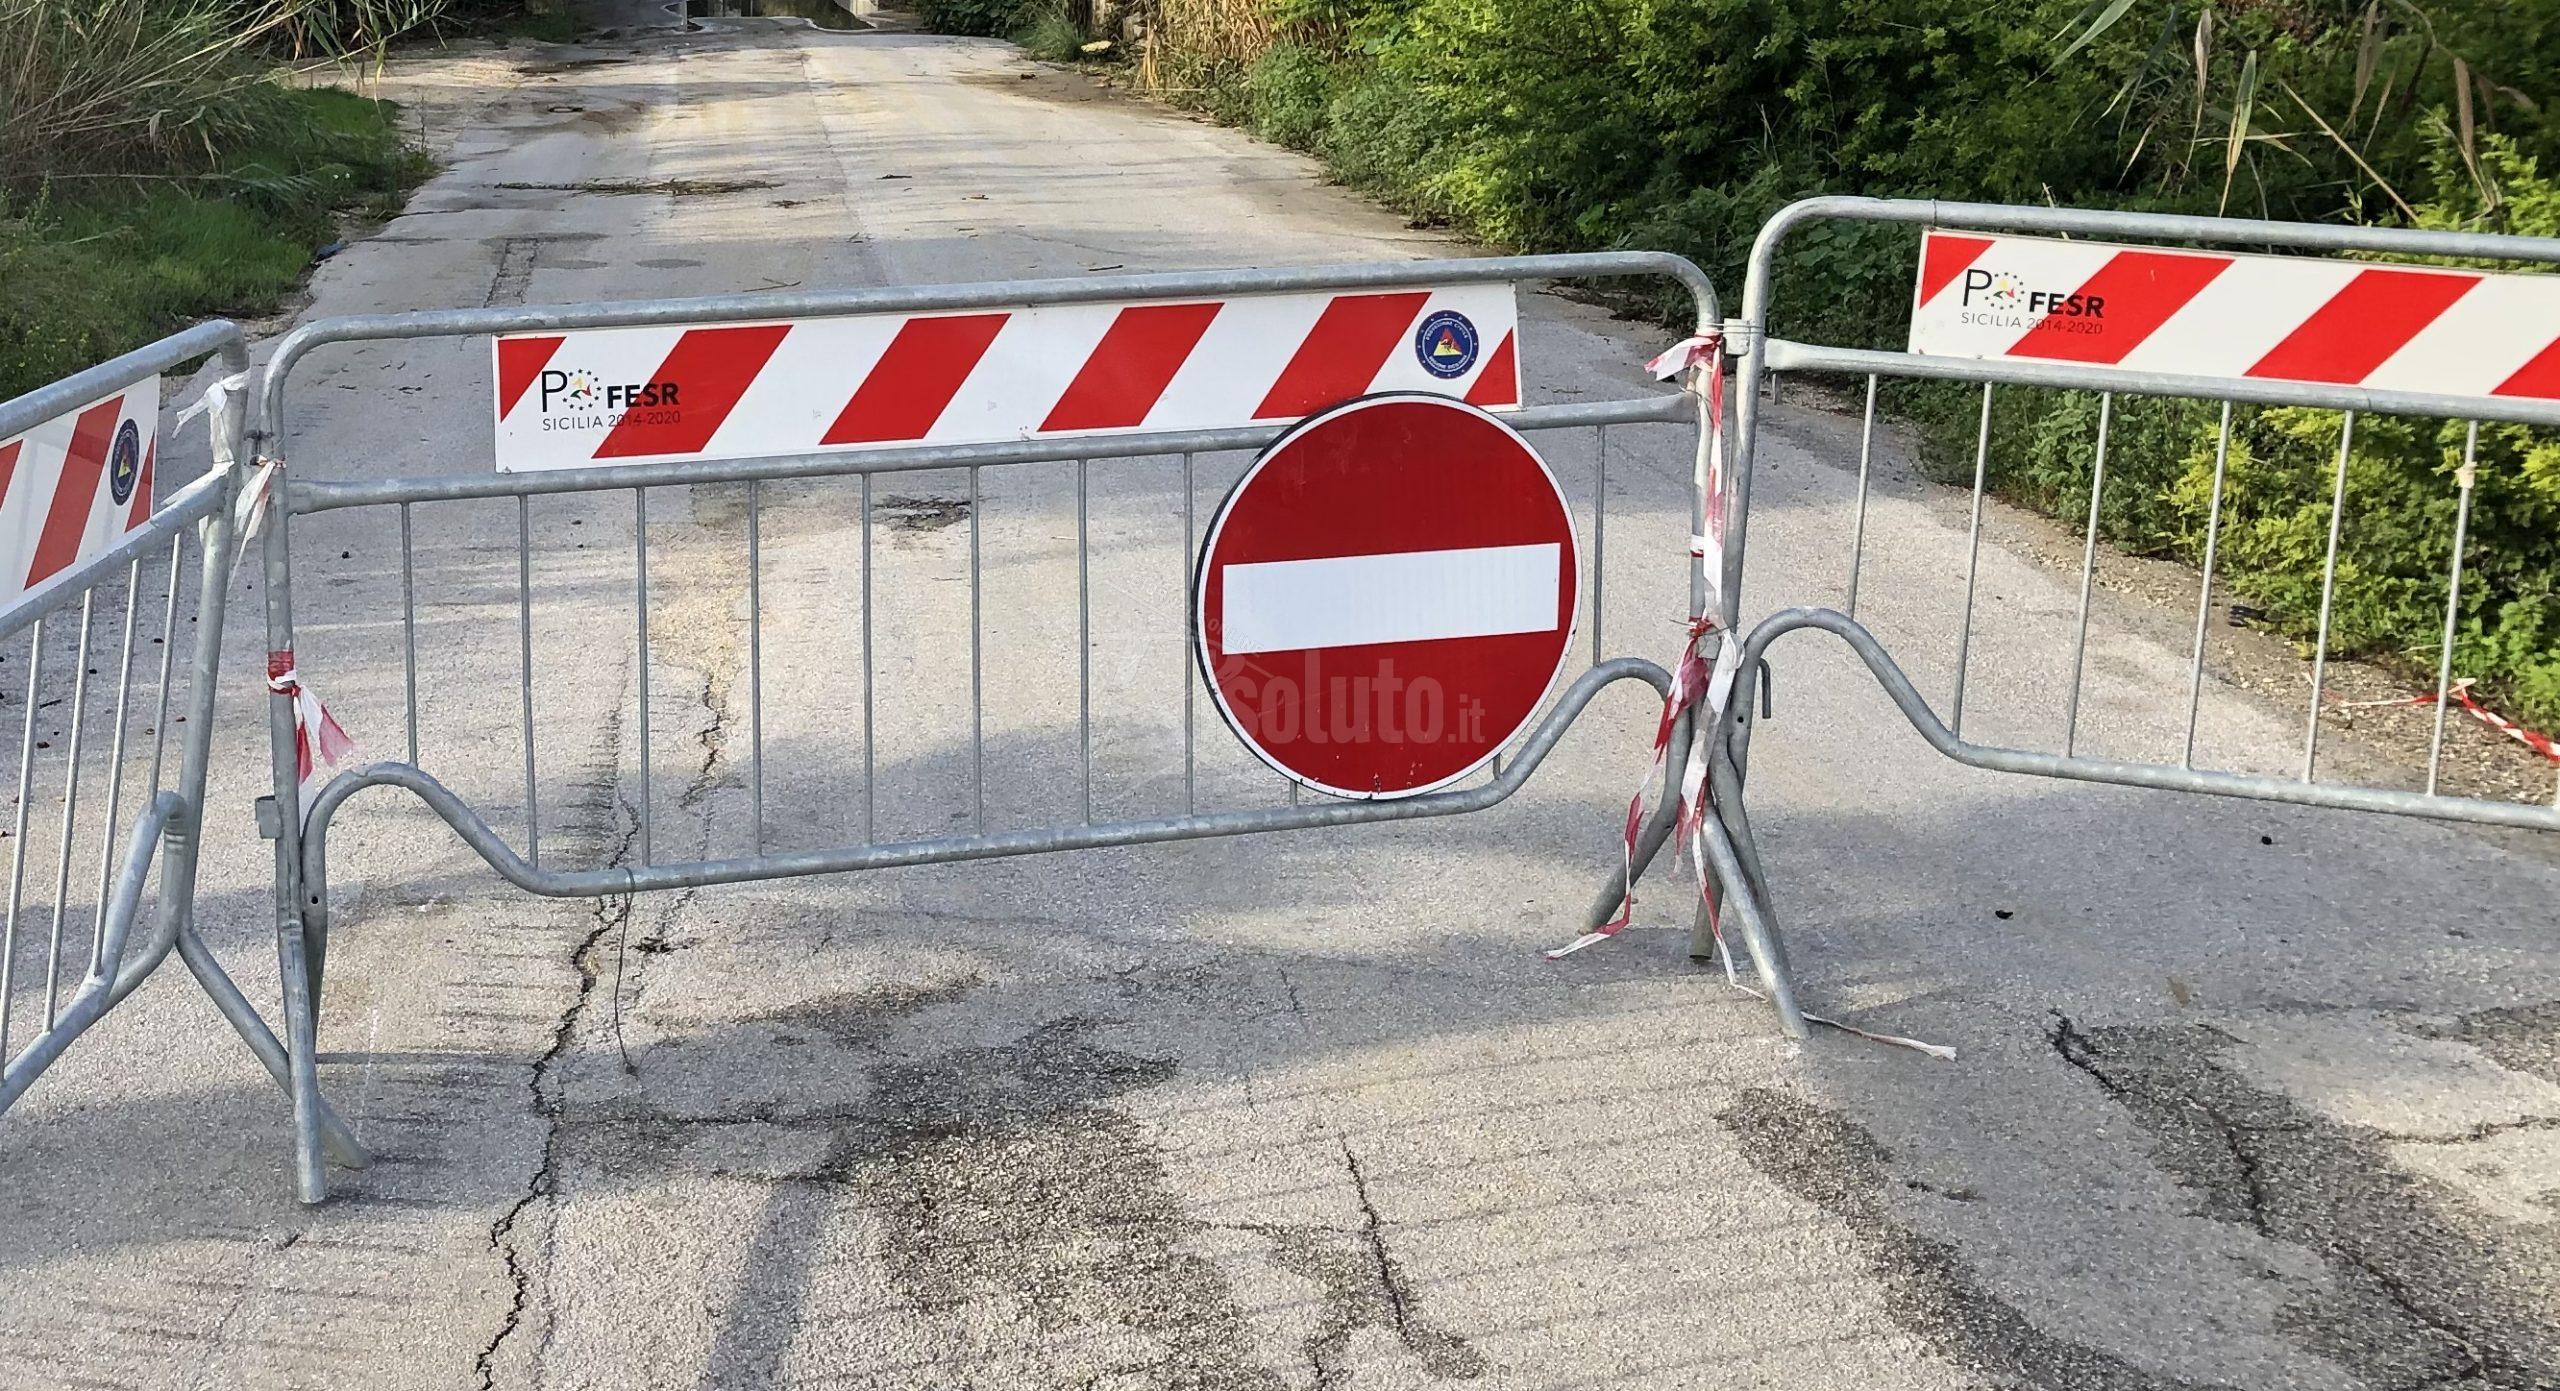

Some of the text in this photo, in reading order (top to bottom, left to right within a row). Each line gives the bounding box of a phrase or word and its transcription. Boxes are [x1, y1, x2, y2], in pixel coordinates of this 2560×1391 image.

[2029, 291, 2105, 319] FESR
[1961, 312, 2103, 335] SICILIA 2014-2020
[606, 382, 681, 409] FESR
[542, 410, 681, 432] SICILIA 2014-2020
